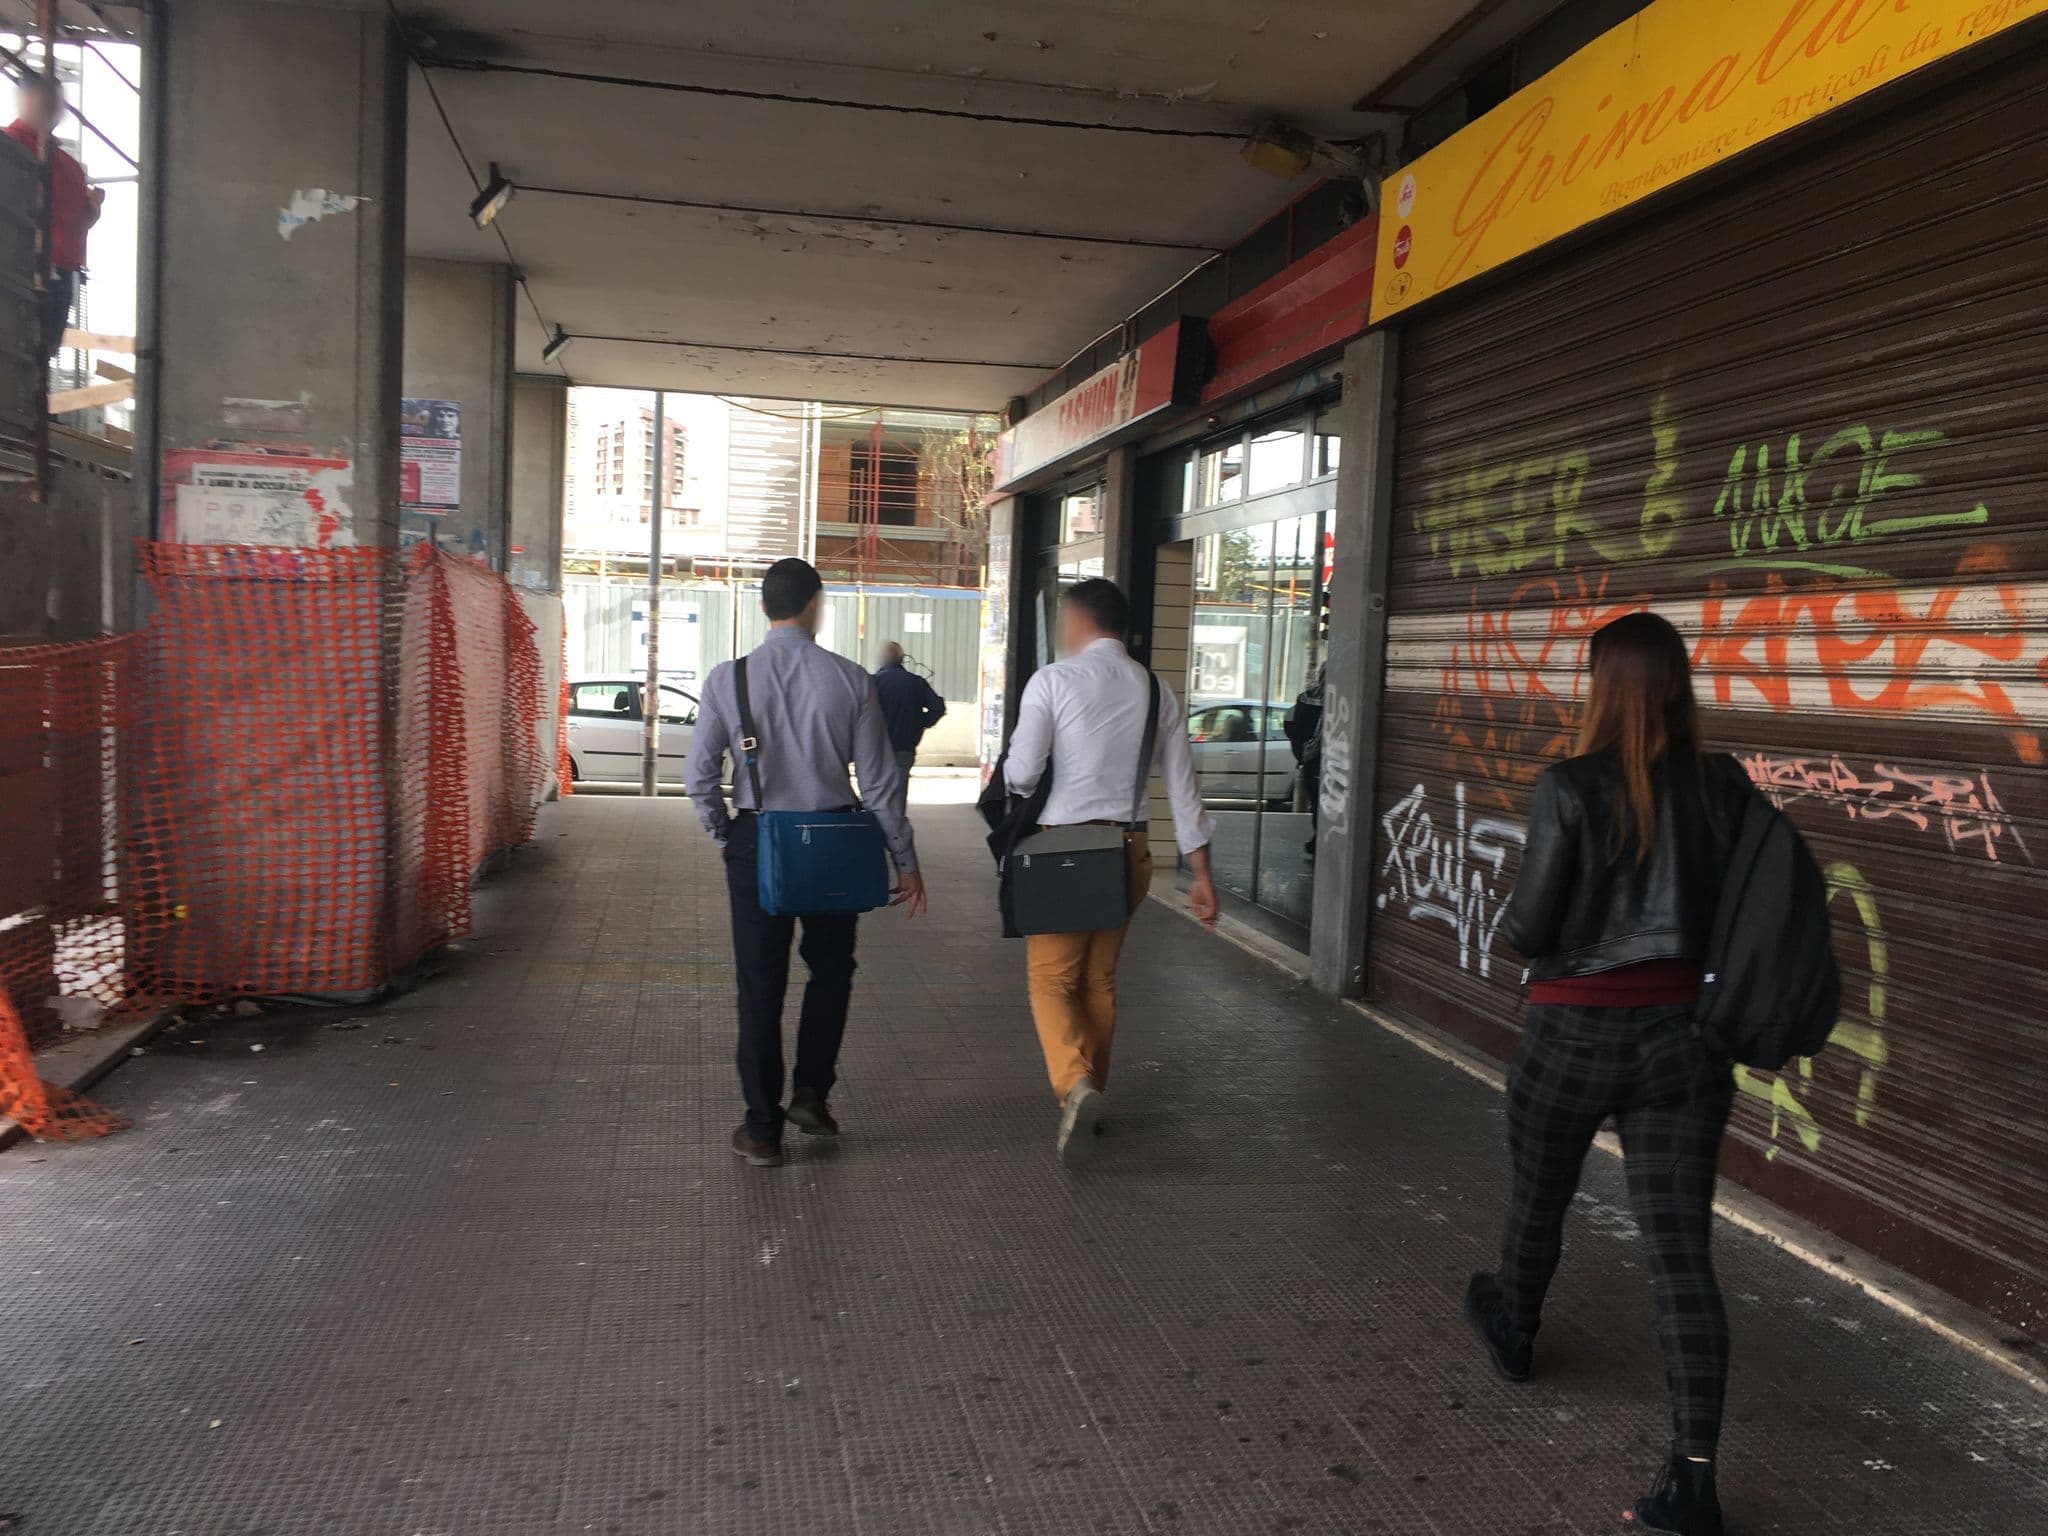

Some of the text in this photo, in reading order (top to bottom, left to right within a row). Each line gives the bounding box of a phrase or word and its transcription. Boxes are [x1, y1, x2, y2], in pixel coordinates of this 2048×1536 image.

[1600, 126, 1738, 204] Bomboniere
[1744, 117, 1759, 138] e
[1764, 43, 1889, 128] Articoli
[1899, 22, 1943, 63] da
